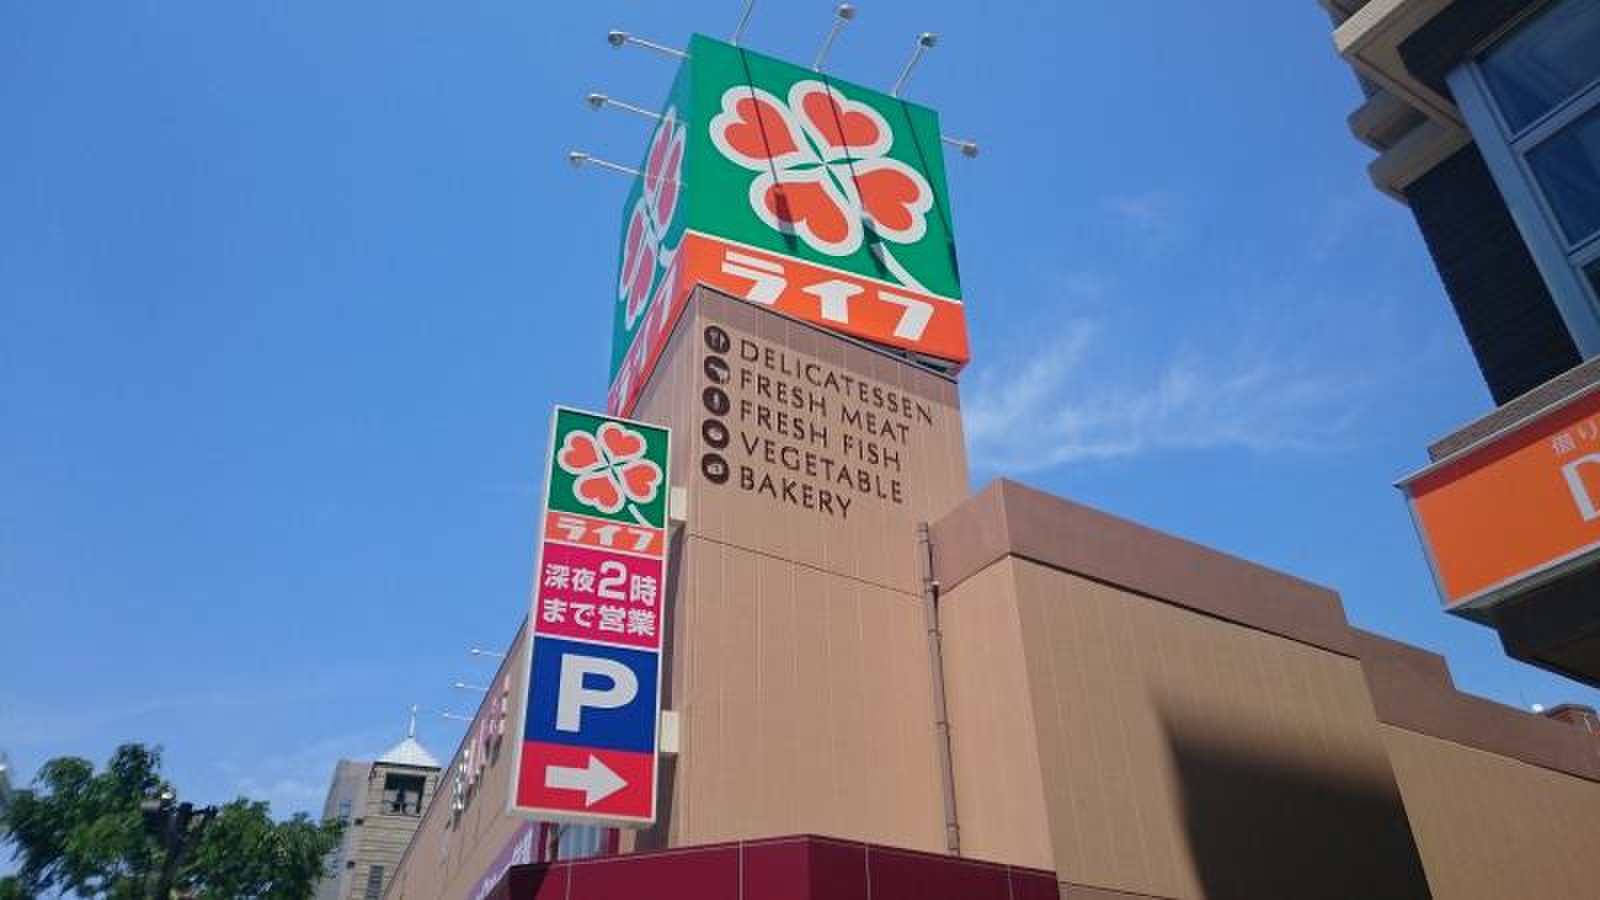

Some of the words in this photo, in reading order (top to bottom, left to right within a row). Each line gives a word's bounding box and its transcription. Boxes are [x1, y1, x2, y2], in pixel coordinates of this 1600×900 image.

[721, 251, 934, 341] ライフ
[741, 340, 933, 426] DELICATESSEN
[741, 369, 826, 416] FRESH
[841, 406, 910, 444] MEAT
[741, 400, 828, 448] FRESH
[844, 434, 901, 472] FISH
[741, 432, 903, 503] VEGETABLE
[740, 467, 851, 519] BAKERY
[558, 516, 655, 551] ライフ
[544, 561, 656, 606] 深夜2時
[544, 599, 656, 636] まで営業
[556, 654, 639, 732] P
